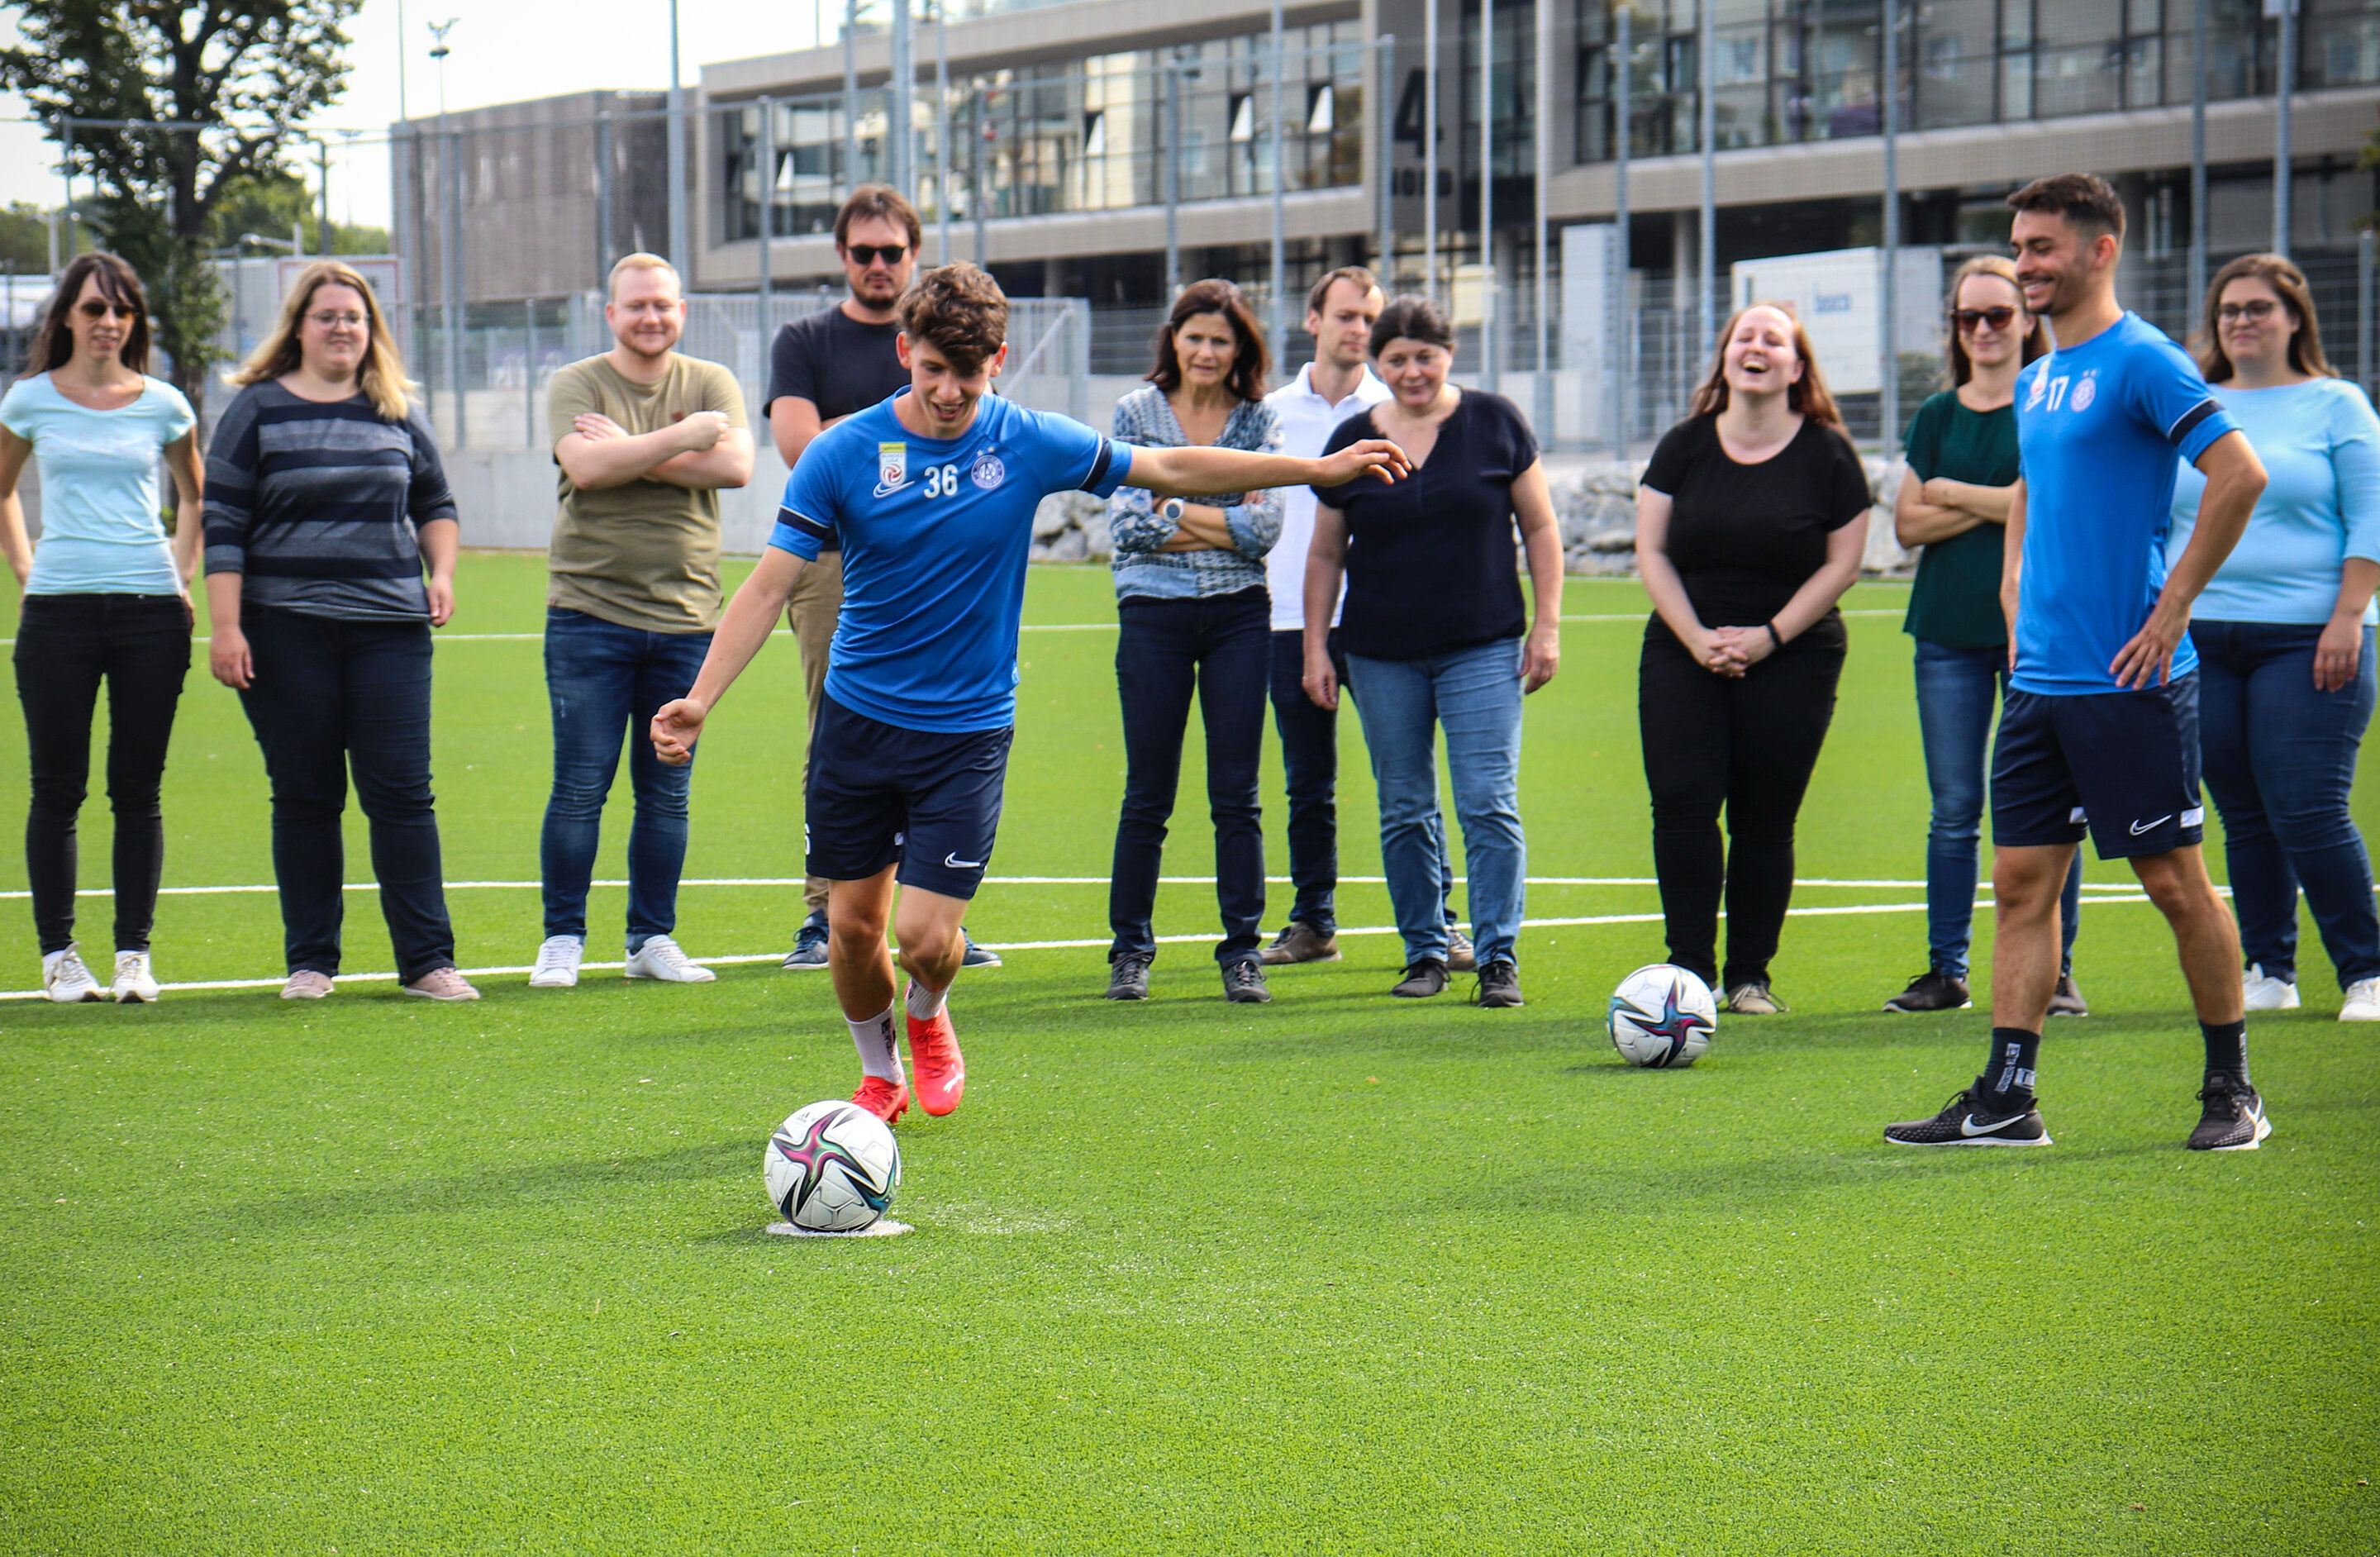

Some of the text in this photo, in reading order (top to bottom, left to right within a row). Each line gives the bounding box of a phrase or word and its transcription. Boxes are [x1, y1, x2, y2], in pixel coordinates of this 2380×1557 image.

[1394, 69, 1442, 158] 4
[2046, 375, 2070, 412] 17
[923, 464, 958, 498] 36
